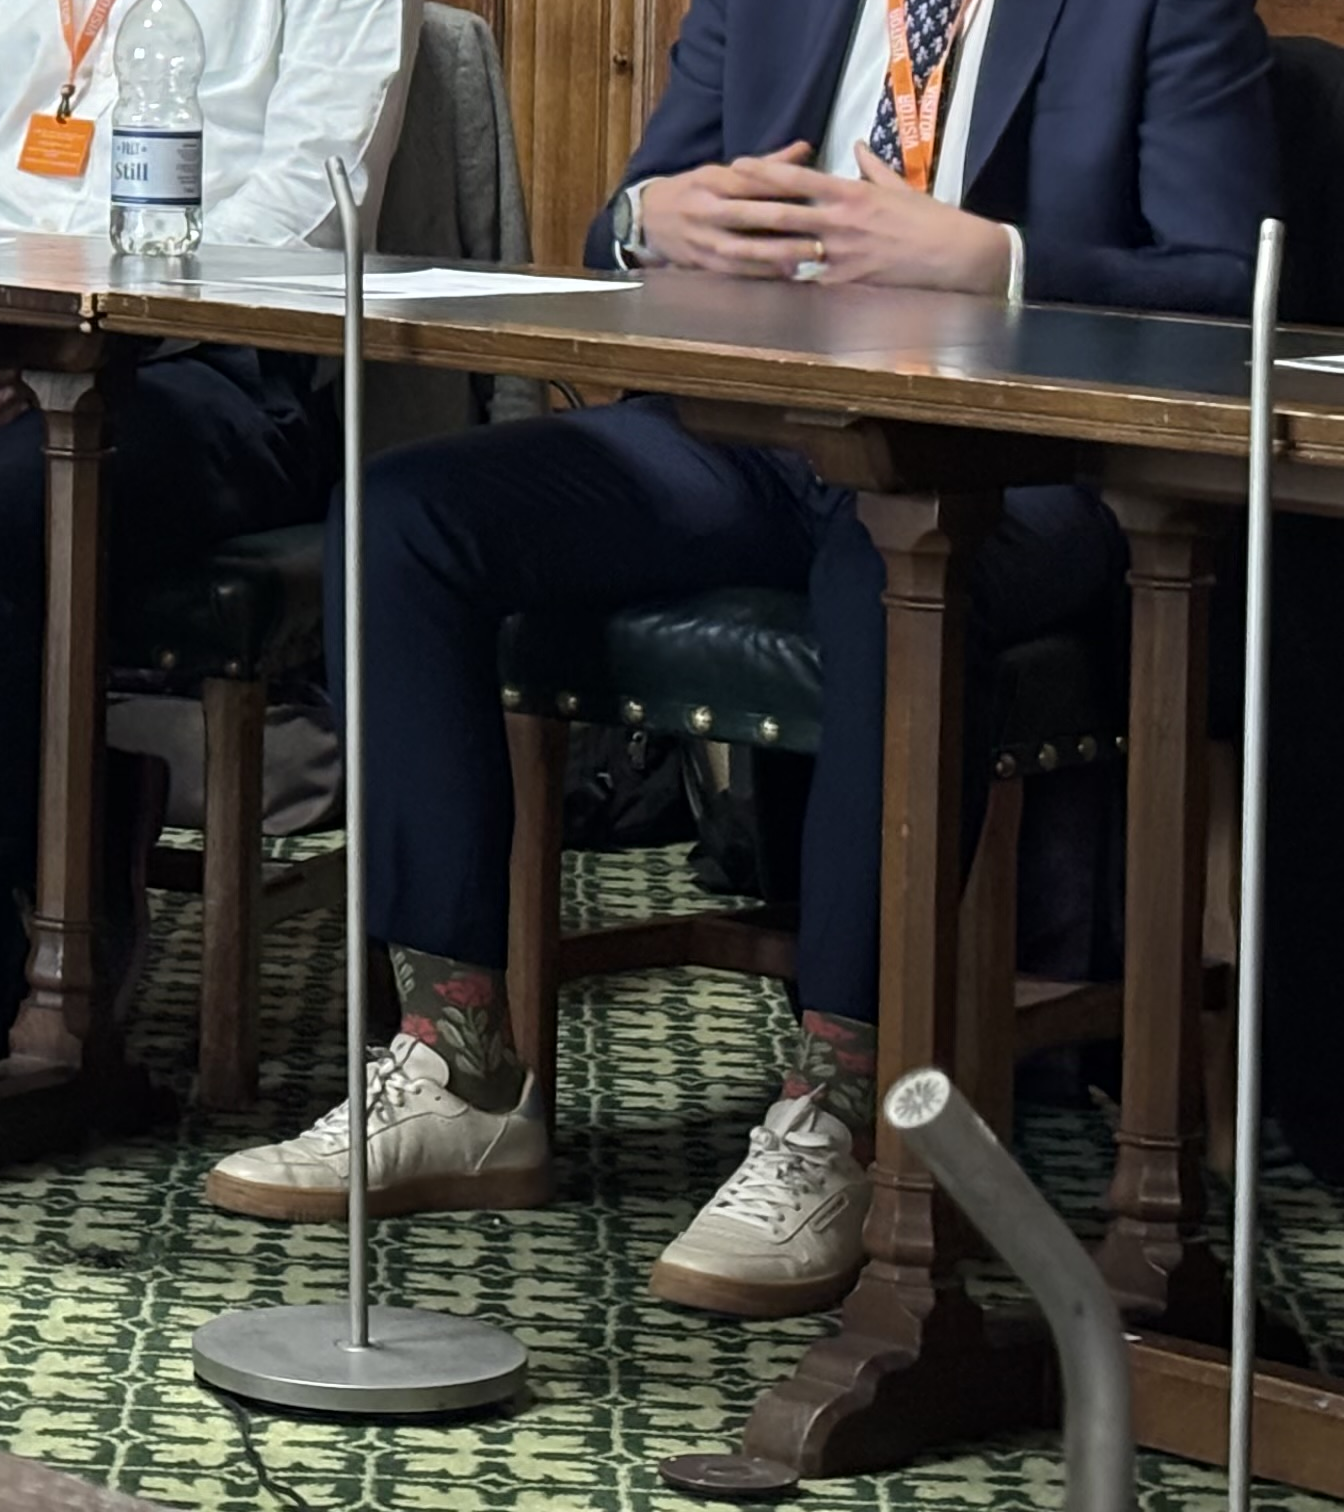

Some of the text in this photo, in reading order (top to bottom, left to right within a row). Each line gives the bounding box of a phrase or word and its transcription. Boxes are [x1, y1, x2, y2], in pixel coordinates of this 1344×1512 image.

[889, 8, 907, 63] VISITOR
[897, 93, 919, 149] VISITOR
[920, 87, 939, 142] VISITOR
[115, 161, 149, 182] Still
